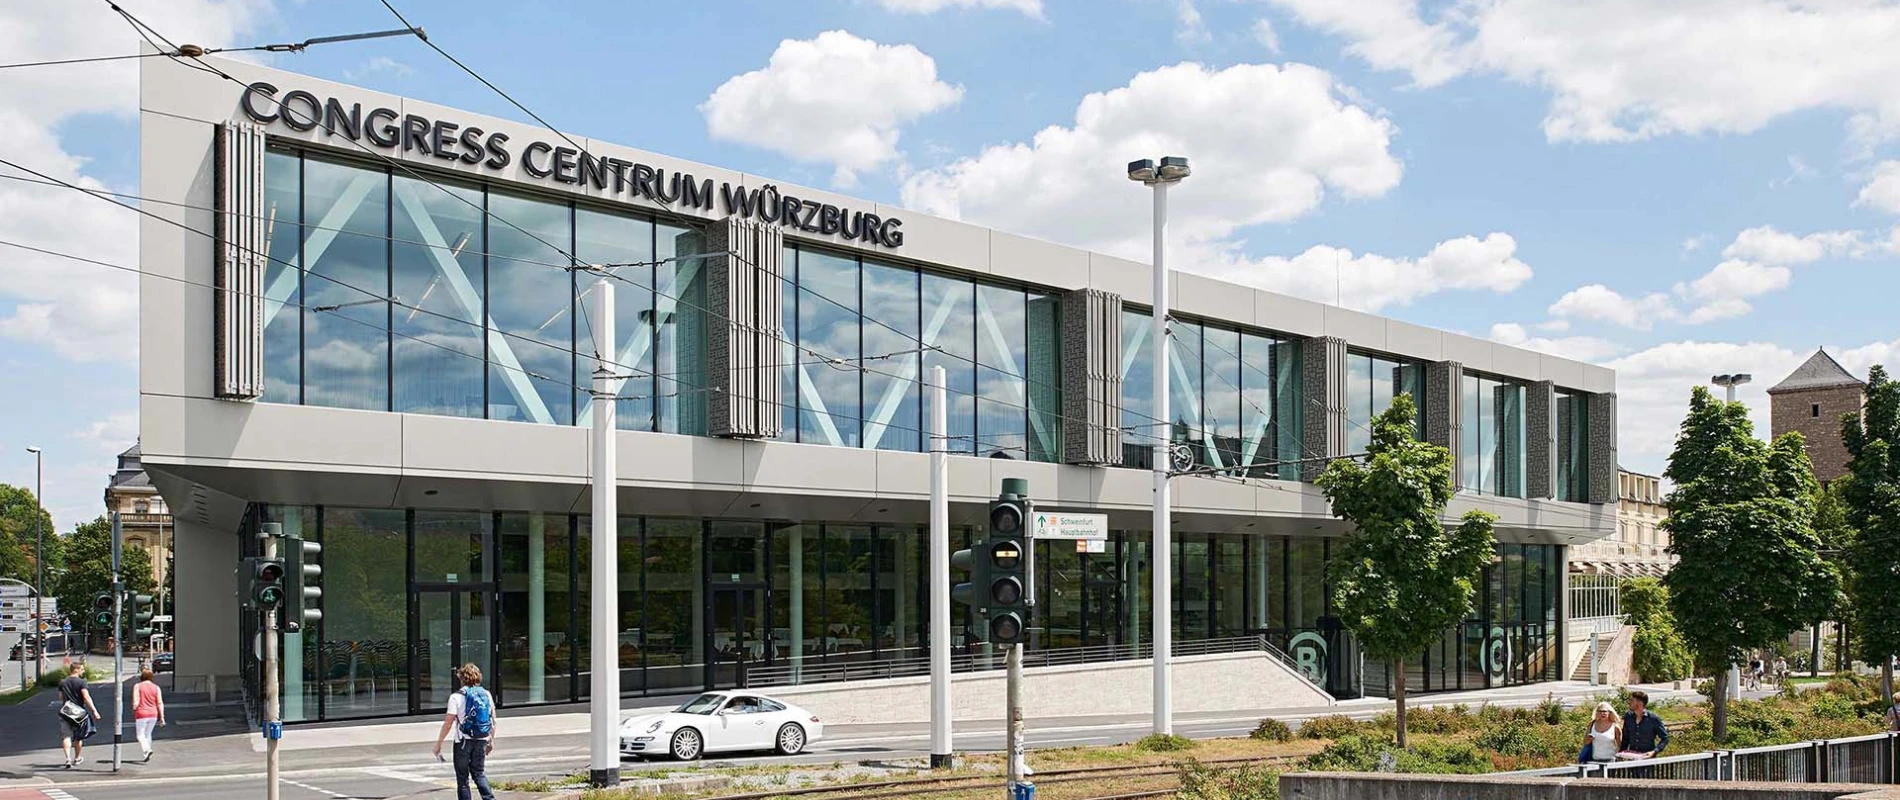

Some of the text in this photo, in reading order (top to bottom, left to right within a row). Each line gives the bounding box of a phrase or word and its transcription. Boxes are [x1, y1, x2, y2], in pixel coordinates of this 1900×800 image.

[241, 82, 904, 248] CONGRESS CENTRUM WÜRZBURG
[1060, 517, 1093, 525] Schweinfurt
[1060, 528, 1098, 536] Hauptbahnhof
[1297, 646, 1319, 678] B
[1490, 639, 1504, 672] C
